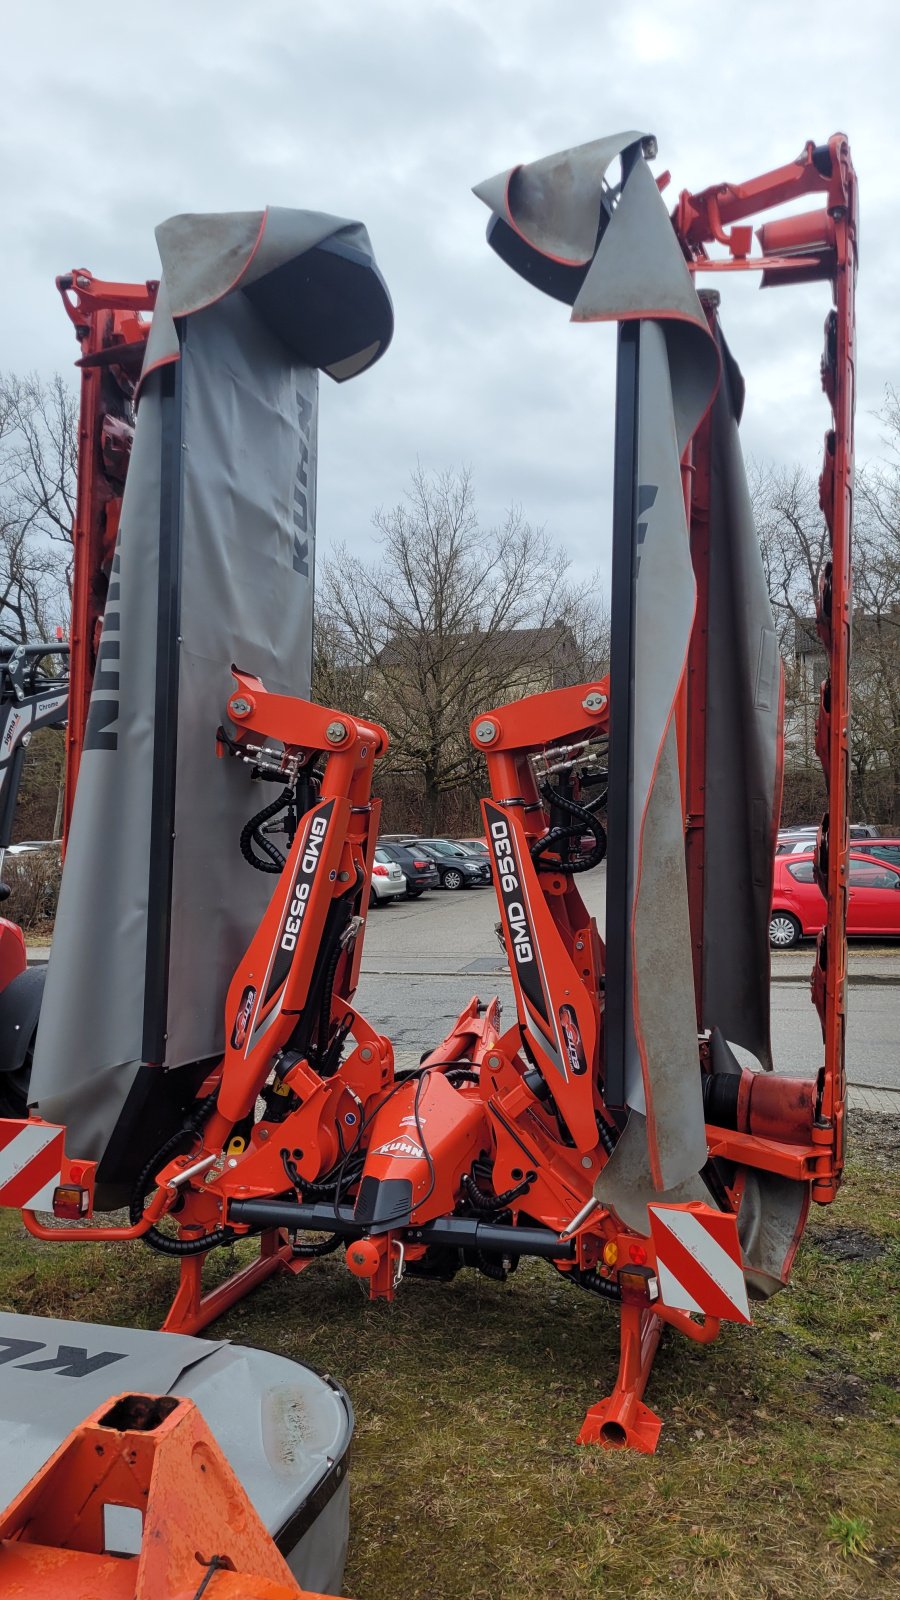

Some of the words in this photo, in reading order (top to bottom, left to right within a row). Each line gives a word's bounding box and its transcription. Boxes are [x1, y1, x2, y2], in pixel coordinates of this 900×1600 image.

[293, 389, 313, 578] KUHN
[5, 720, 16, 745] sigma
[39, 701, 59, 711] Chrome
[302, 816, 327, 874] GMD
[491, 820, 519, 893] 9530
[281, 883, 310, 952] 9530
[508, 901, 533, 964] GMD
[567, 1031, 580, 1070] ELITE
[379, 1142, 424, 1158] KUHN
